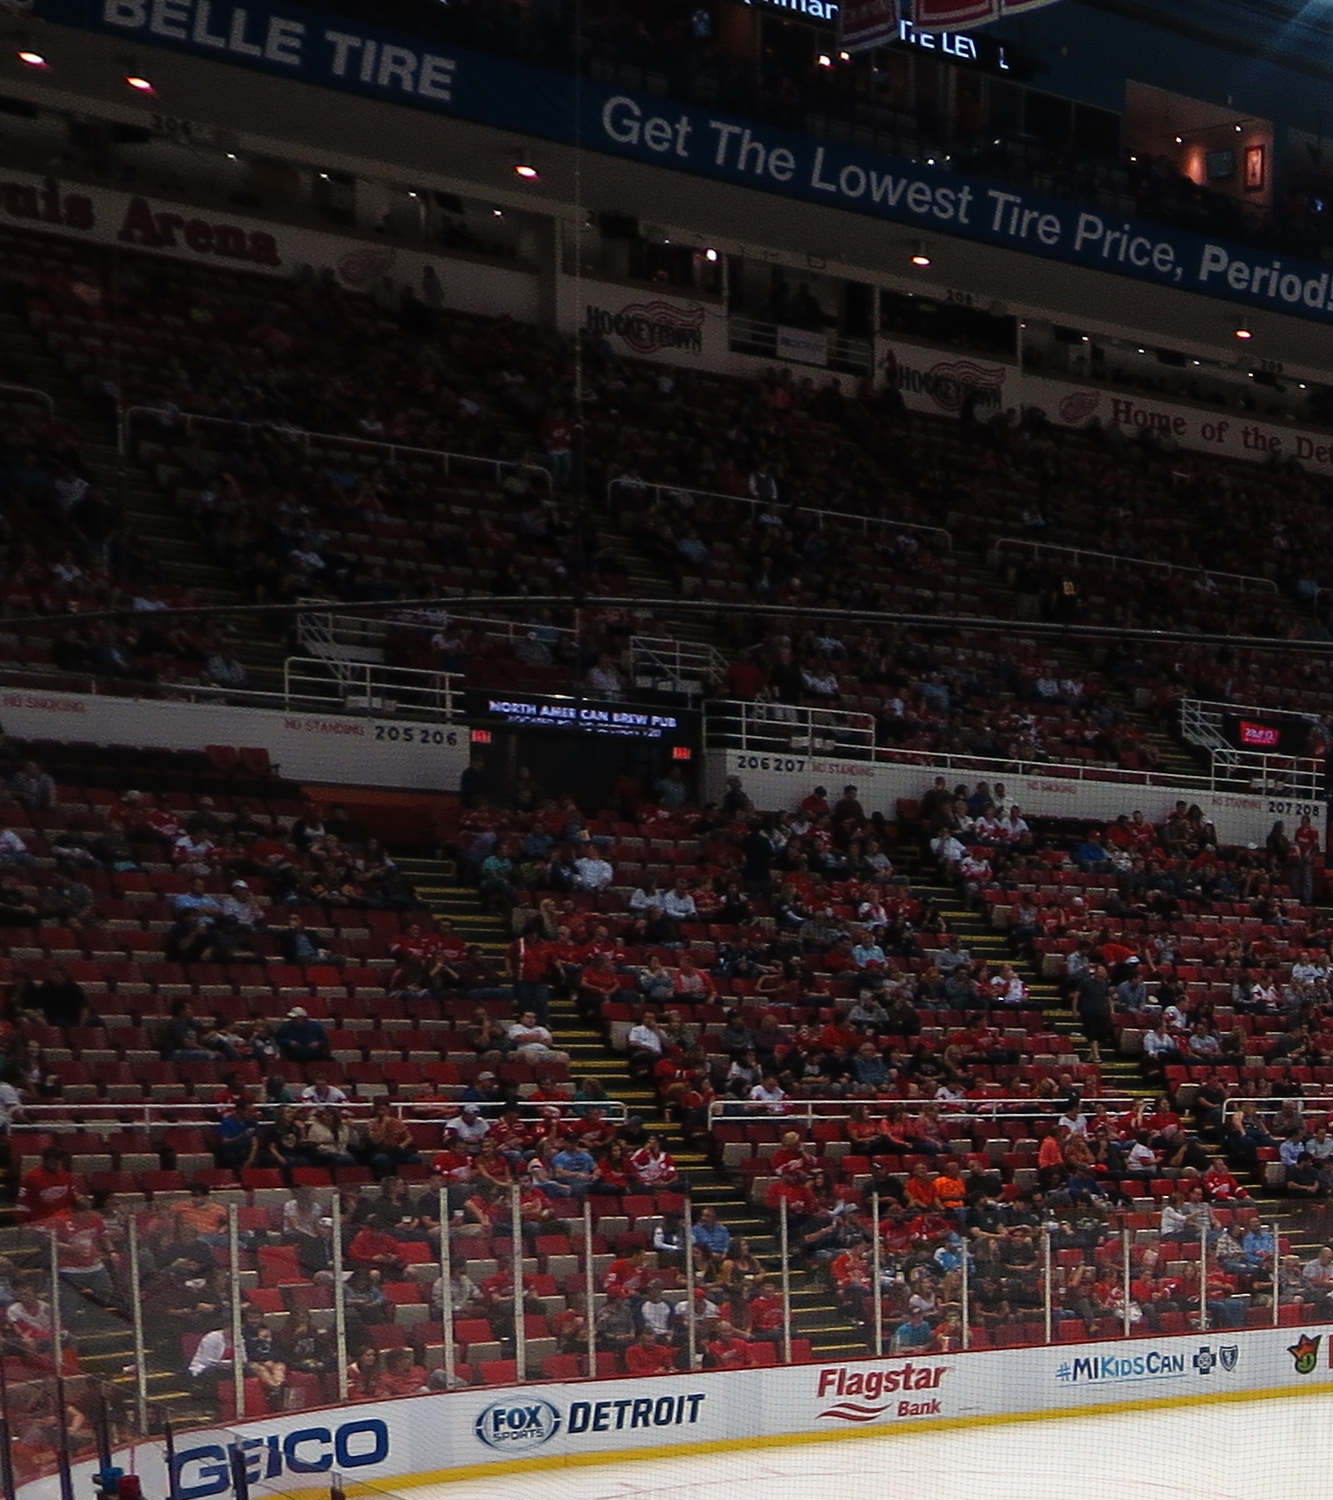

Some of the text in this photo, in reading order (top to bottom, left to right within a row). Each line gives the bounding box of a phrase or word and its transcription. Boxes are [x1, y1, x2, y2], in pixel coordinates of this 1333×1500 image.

[102, 0, 458, 102] BELLE TIRE
[602, 95, 693, 158] Get
[709, 120, 796, 182] The
[811, 146, 974, 226] Lowest
[987, 190, 1063, 245] Tire
[1074, 212, 1185, 281] Price,
[117, 197, 282, 268] Arena
[1112, 397, 1188, 438] Home
[1202, 422, 1230, 444] of
[1242, 425, 1282, 456] the
[487, 700, 538, 717] NORTH
[651, 715, 679, 729] PUB
[305, 720, 458, 746] STANDING 205 206
[737, 755, 806, 773] 206 207
[1268, 801, 1320, 817] 207 208
[816, 1362, 950, 1401] Flagstar
[492, 1405, 542, 1434] FOX
[566, 1393, 706, 1434] DETROIT
[897, 1397, 943, 1419] Bank
[493, 1429, 545, 1443] SPORTS
